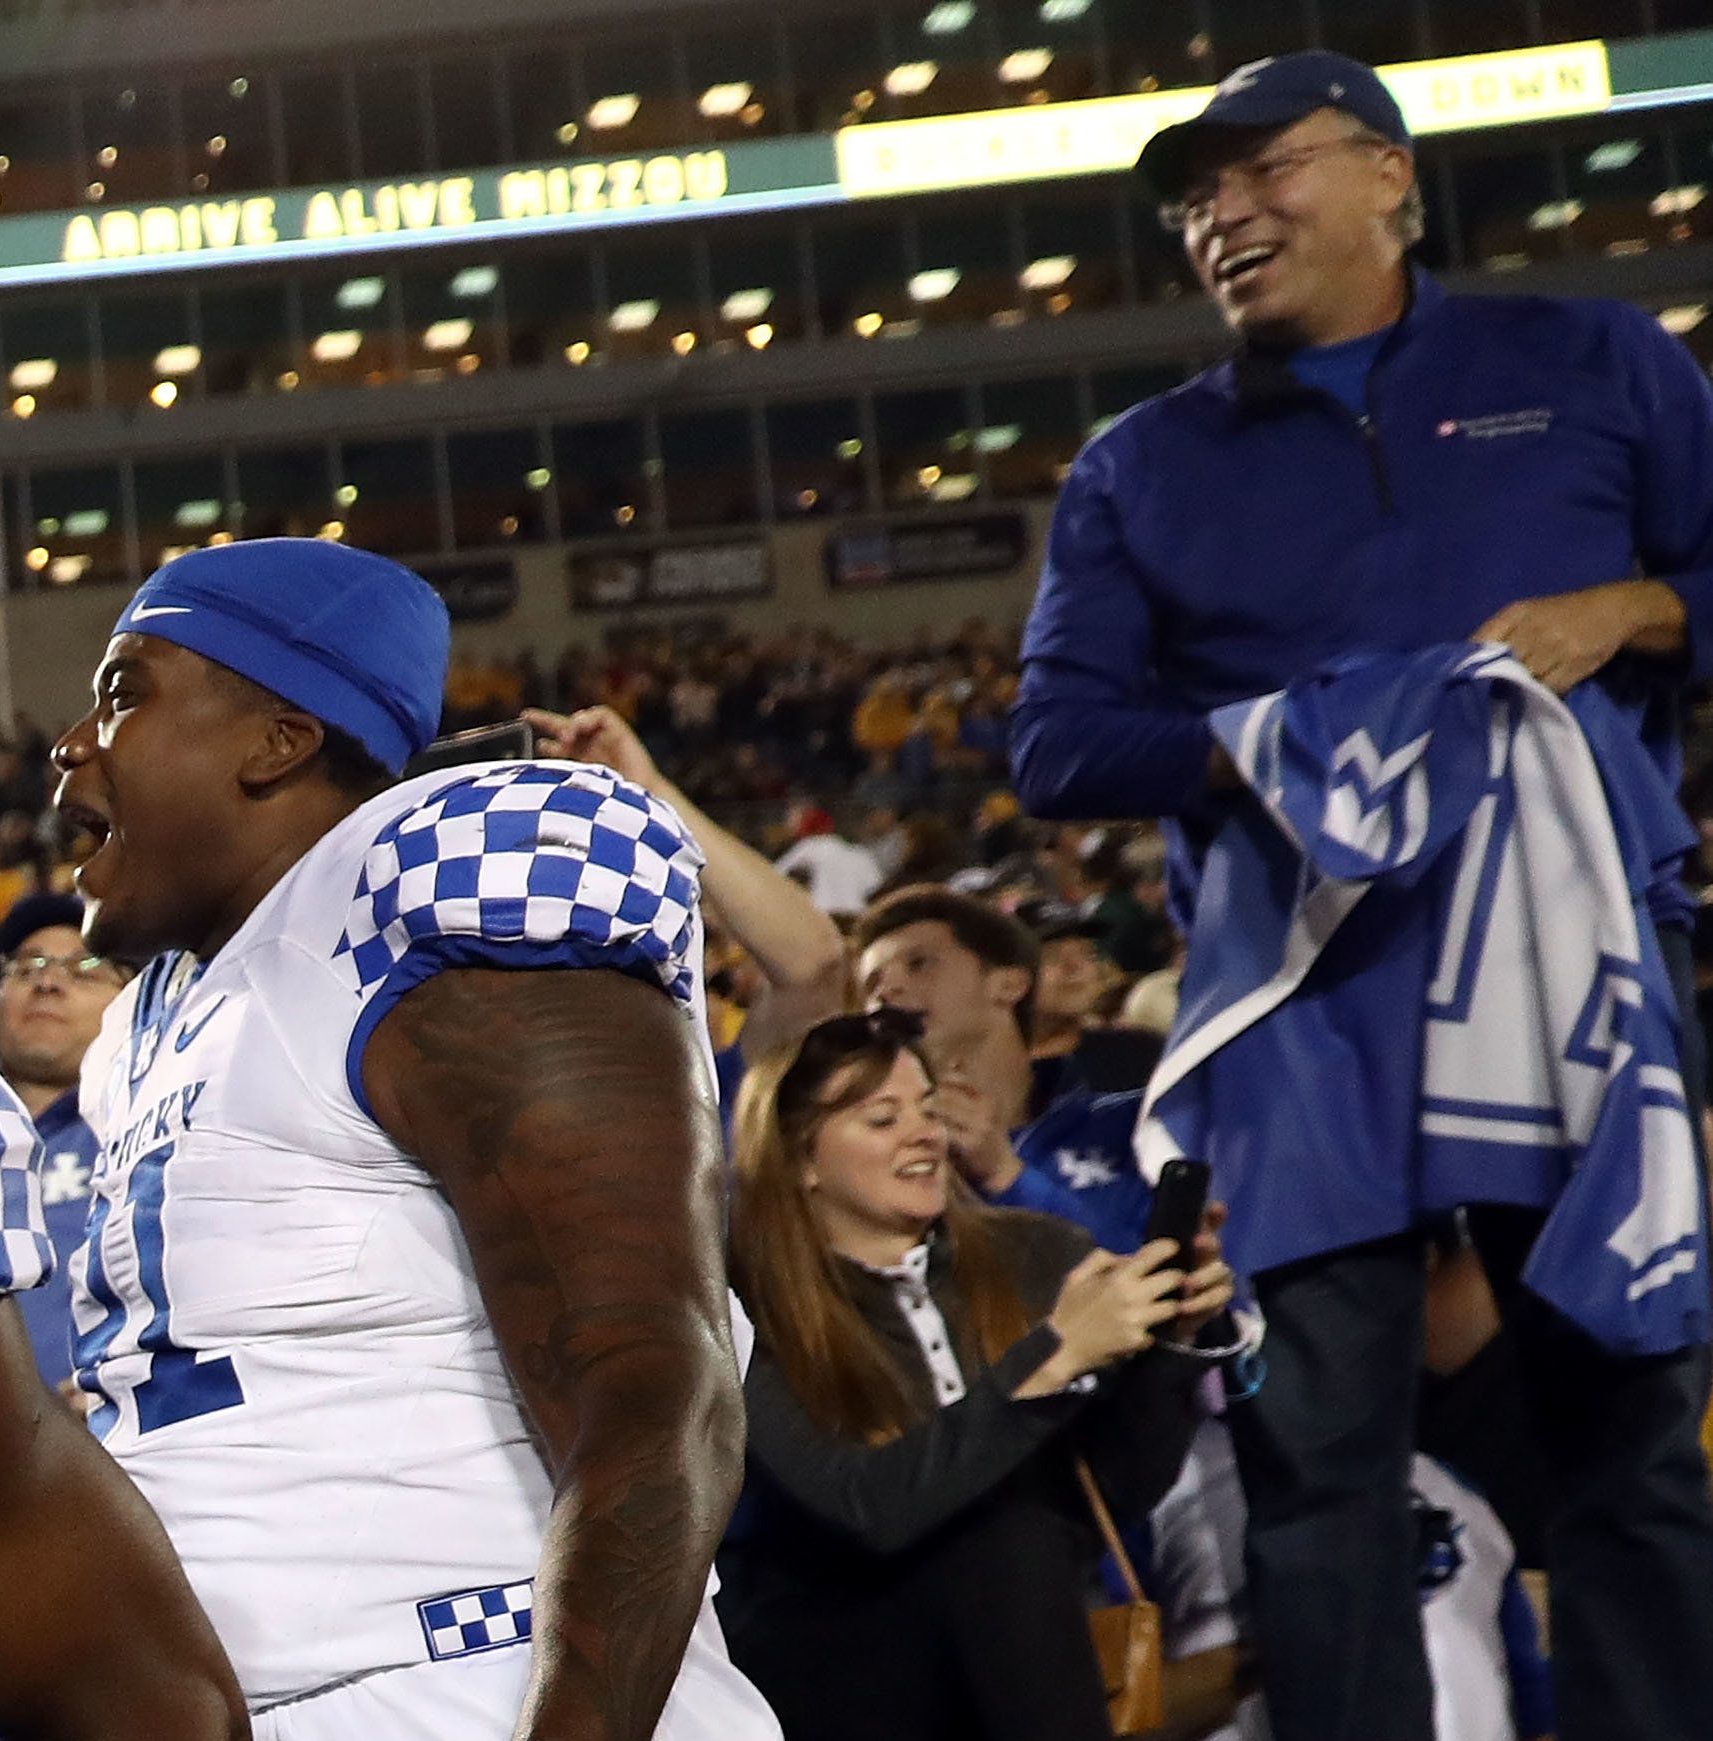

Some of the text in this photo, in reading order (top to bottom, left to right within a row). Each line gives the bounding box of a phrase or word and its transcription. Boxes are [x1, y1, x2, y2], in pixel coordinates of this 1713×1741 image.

[62, 149, 729, 263] ARRIVE ALIVE MIZZOU
